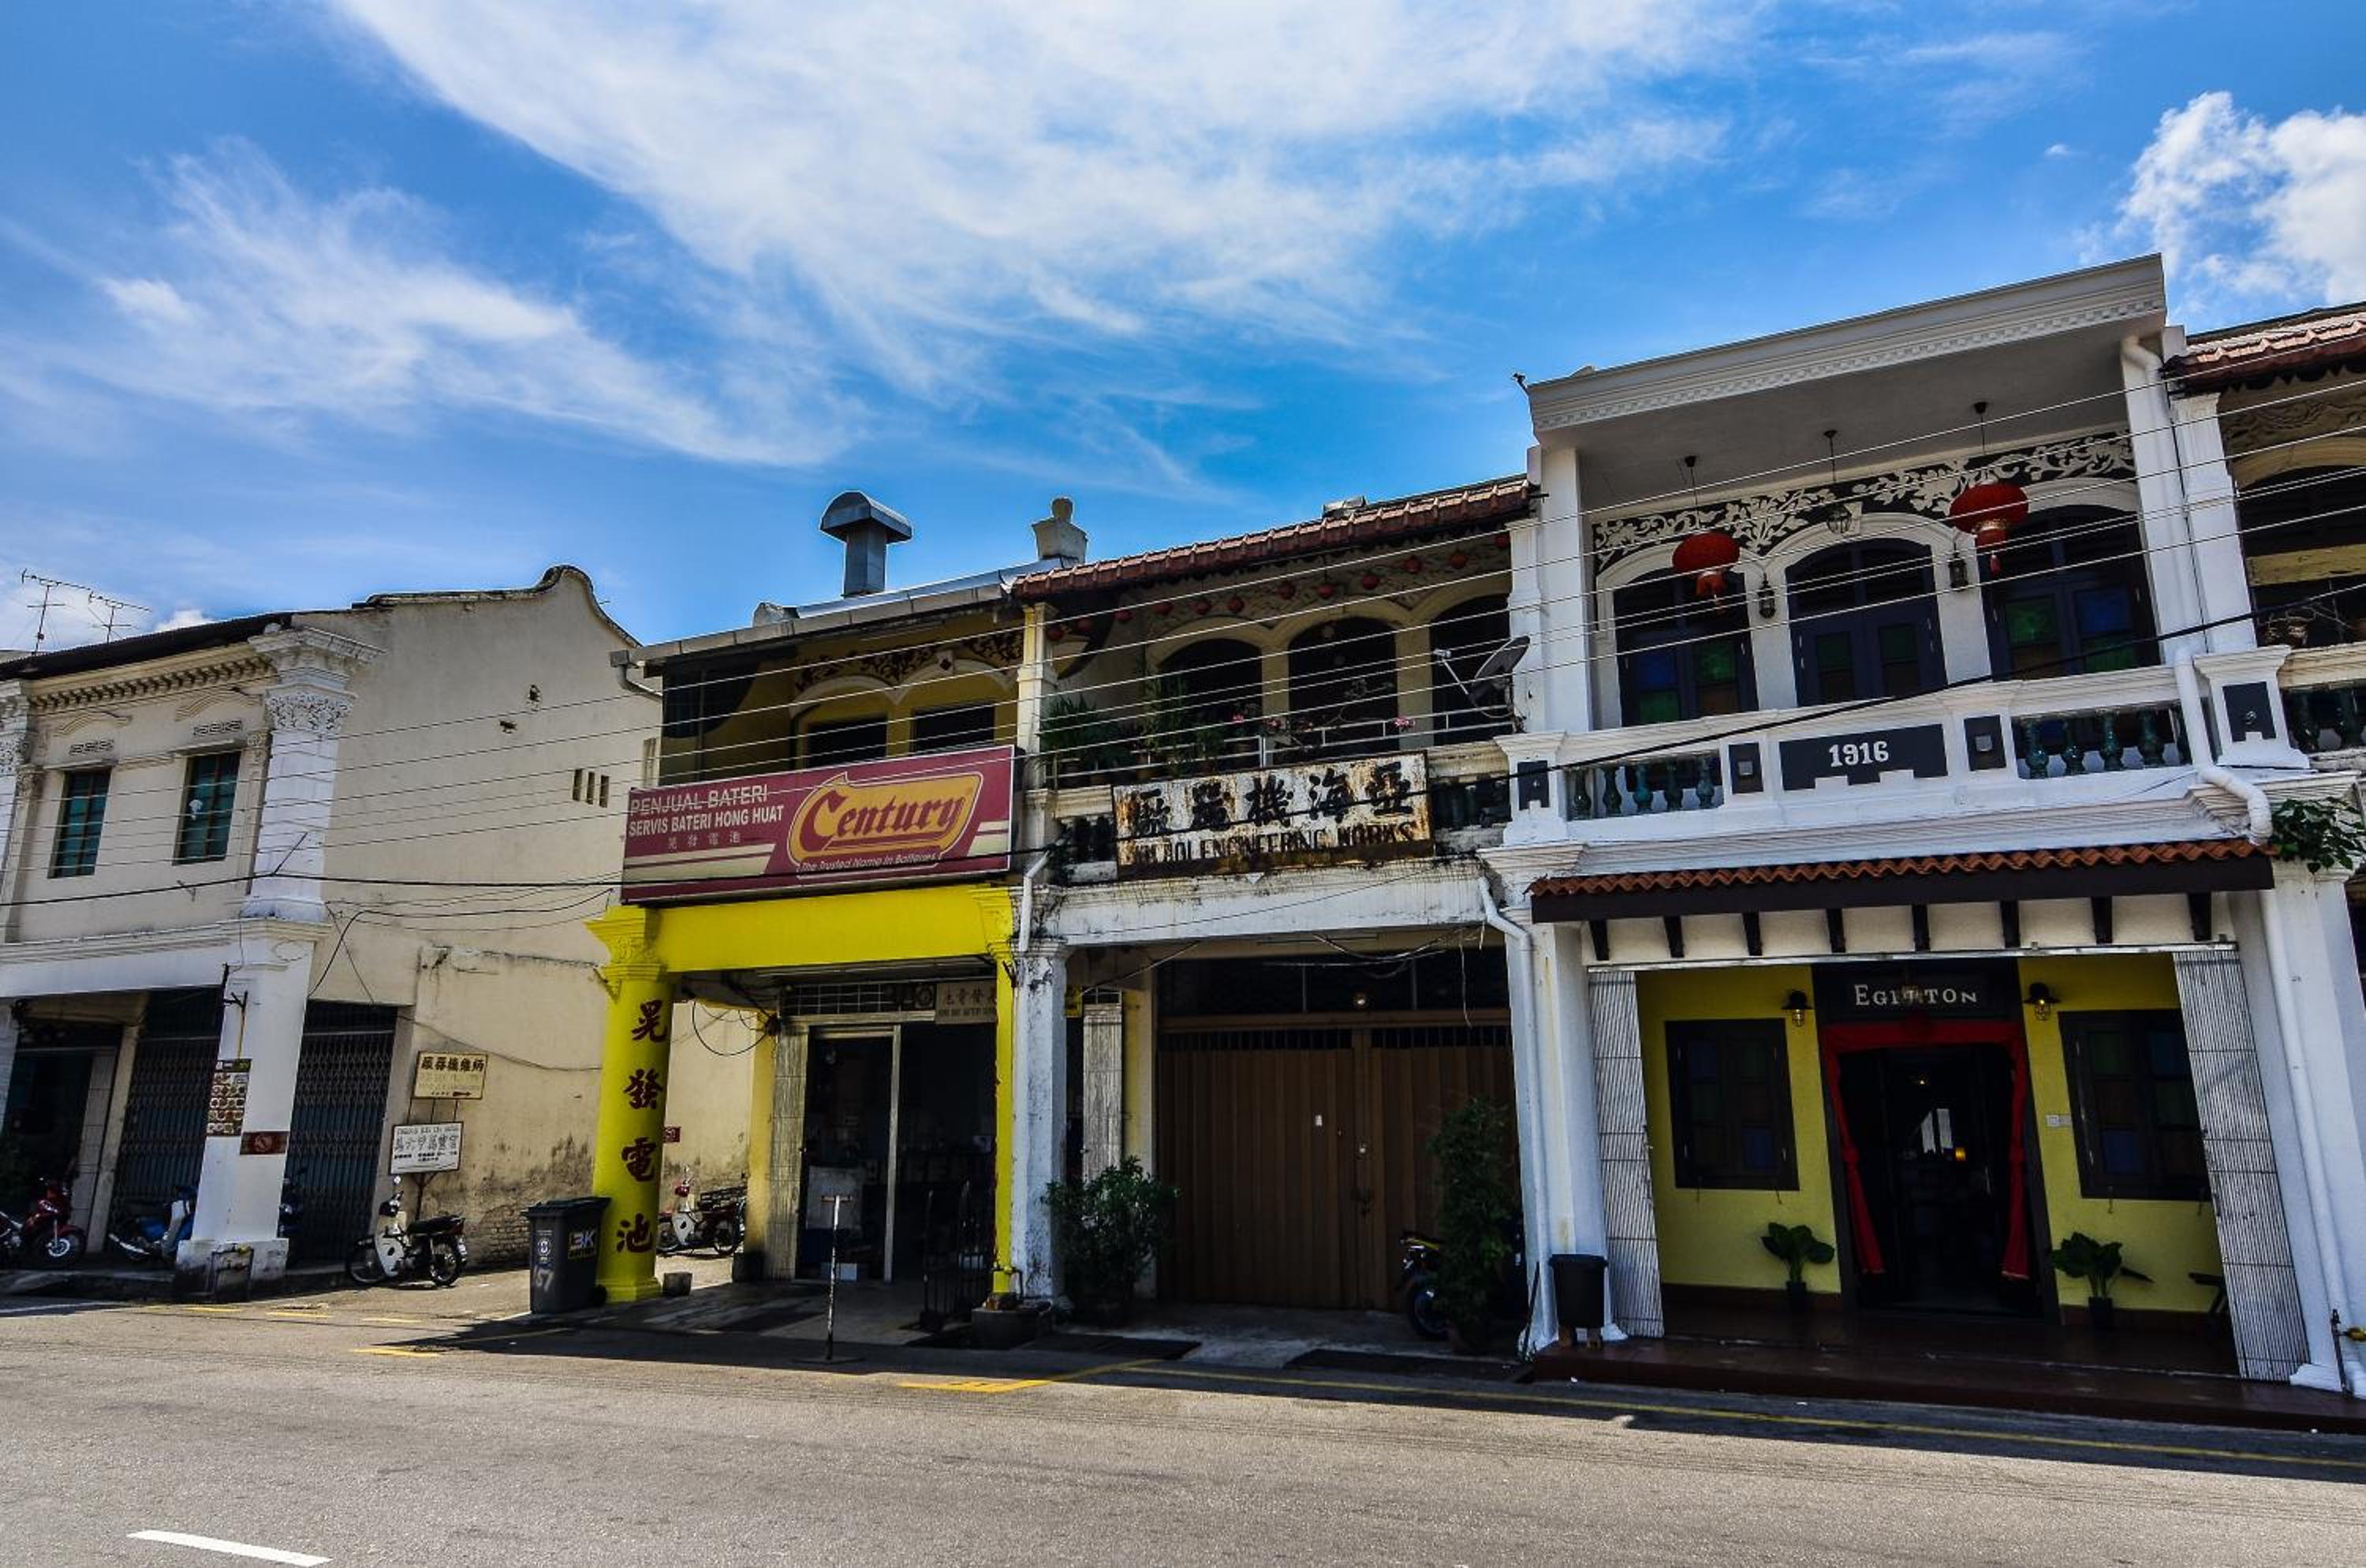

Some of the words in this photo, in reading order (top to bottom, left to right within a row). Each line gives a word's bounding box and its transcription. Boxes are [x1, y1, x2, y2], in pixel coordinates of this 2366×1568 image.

[1829, 741, 1889, 767] 1916
[631, 793, 702, 816] PENJUAL
[707, 784, 768, 808] BATERI
[629, 818, 668, 837] SERVIS
[671, 813, 711, 832] BATERI
[715, 809, 749, 827] HONG
[752, 805, 784, 823] HUAT
[799, 790, 966, 852] Century
